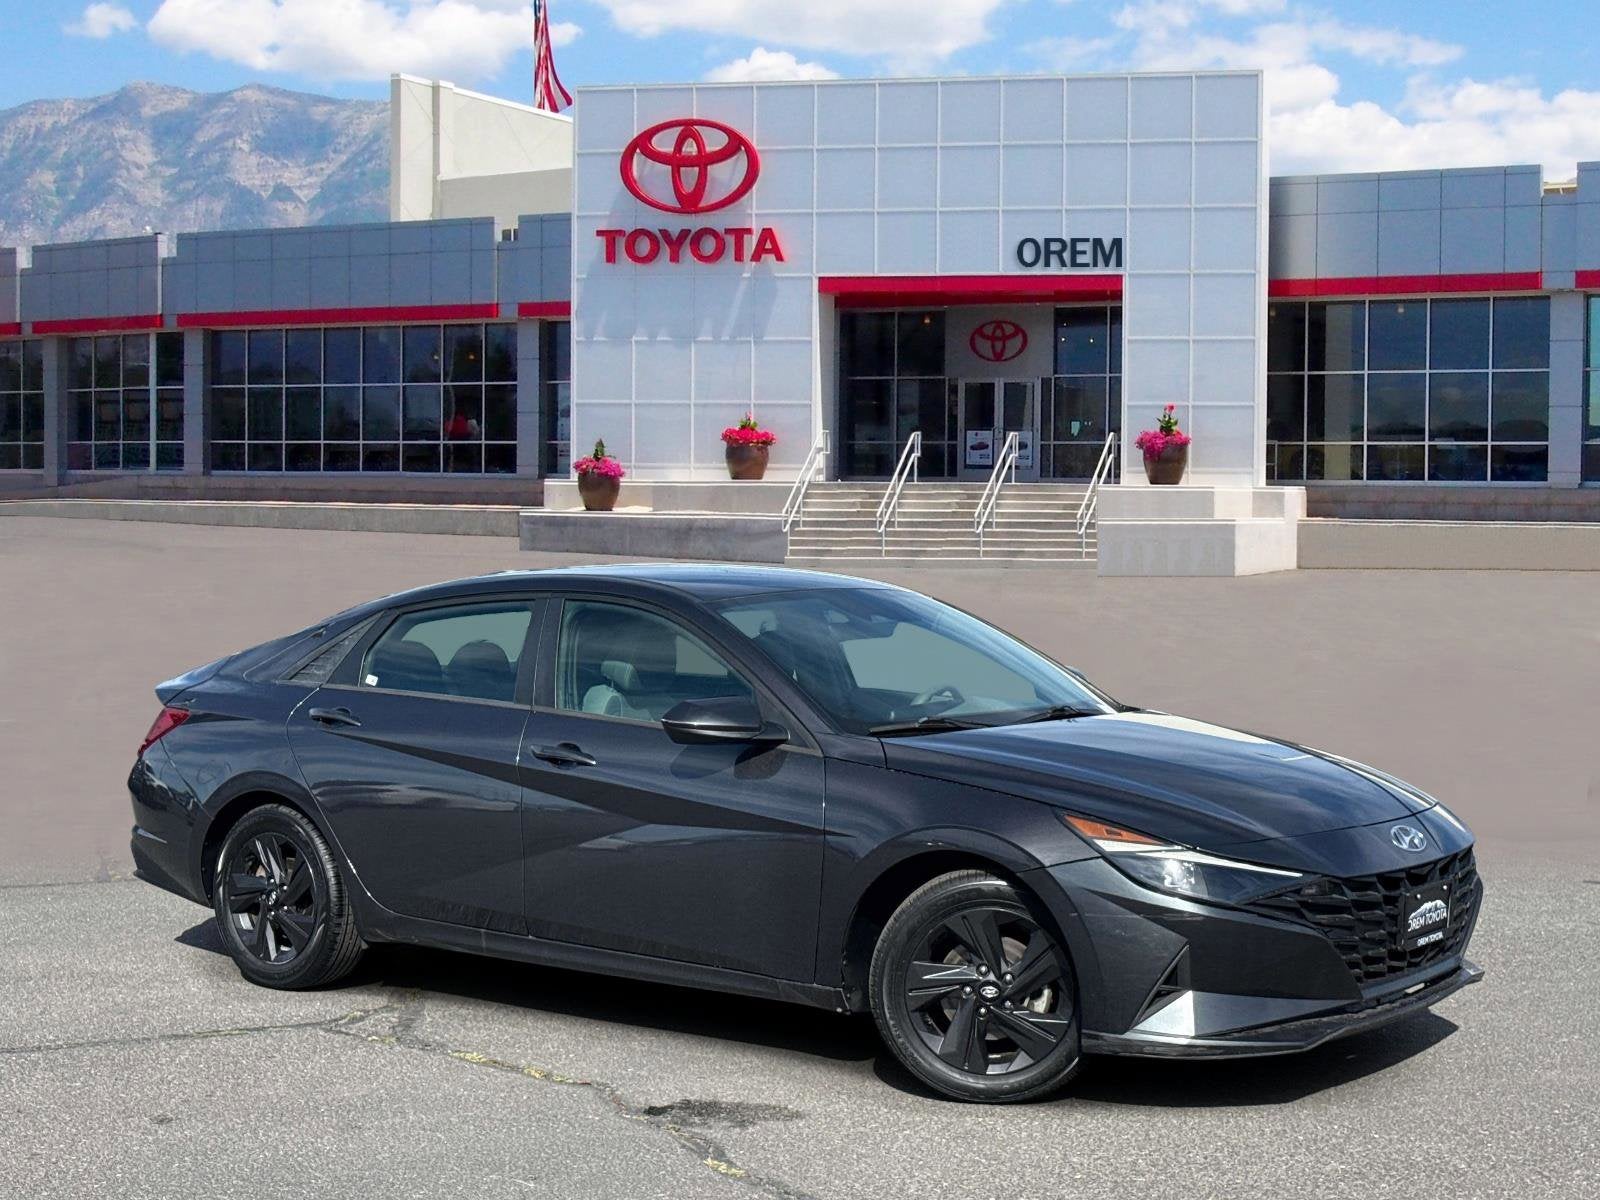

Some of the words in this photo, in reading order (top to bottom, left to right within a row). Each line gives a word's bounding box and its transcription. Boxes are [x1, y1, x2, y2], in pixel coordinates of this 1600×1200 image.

[597, 227, 785, 264] TOYOTA
[1016, 237, 1123, 270] OREM
[1425, 908, 1447, 925] TOYOTA
